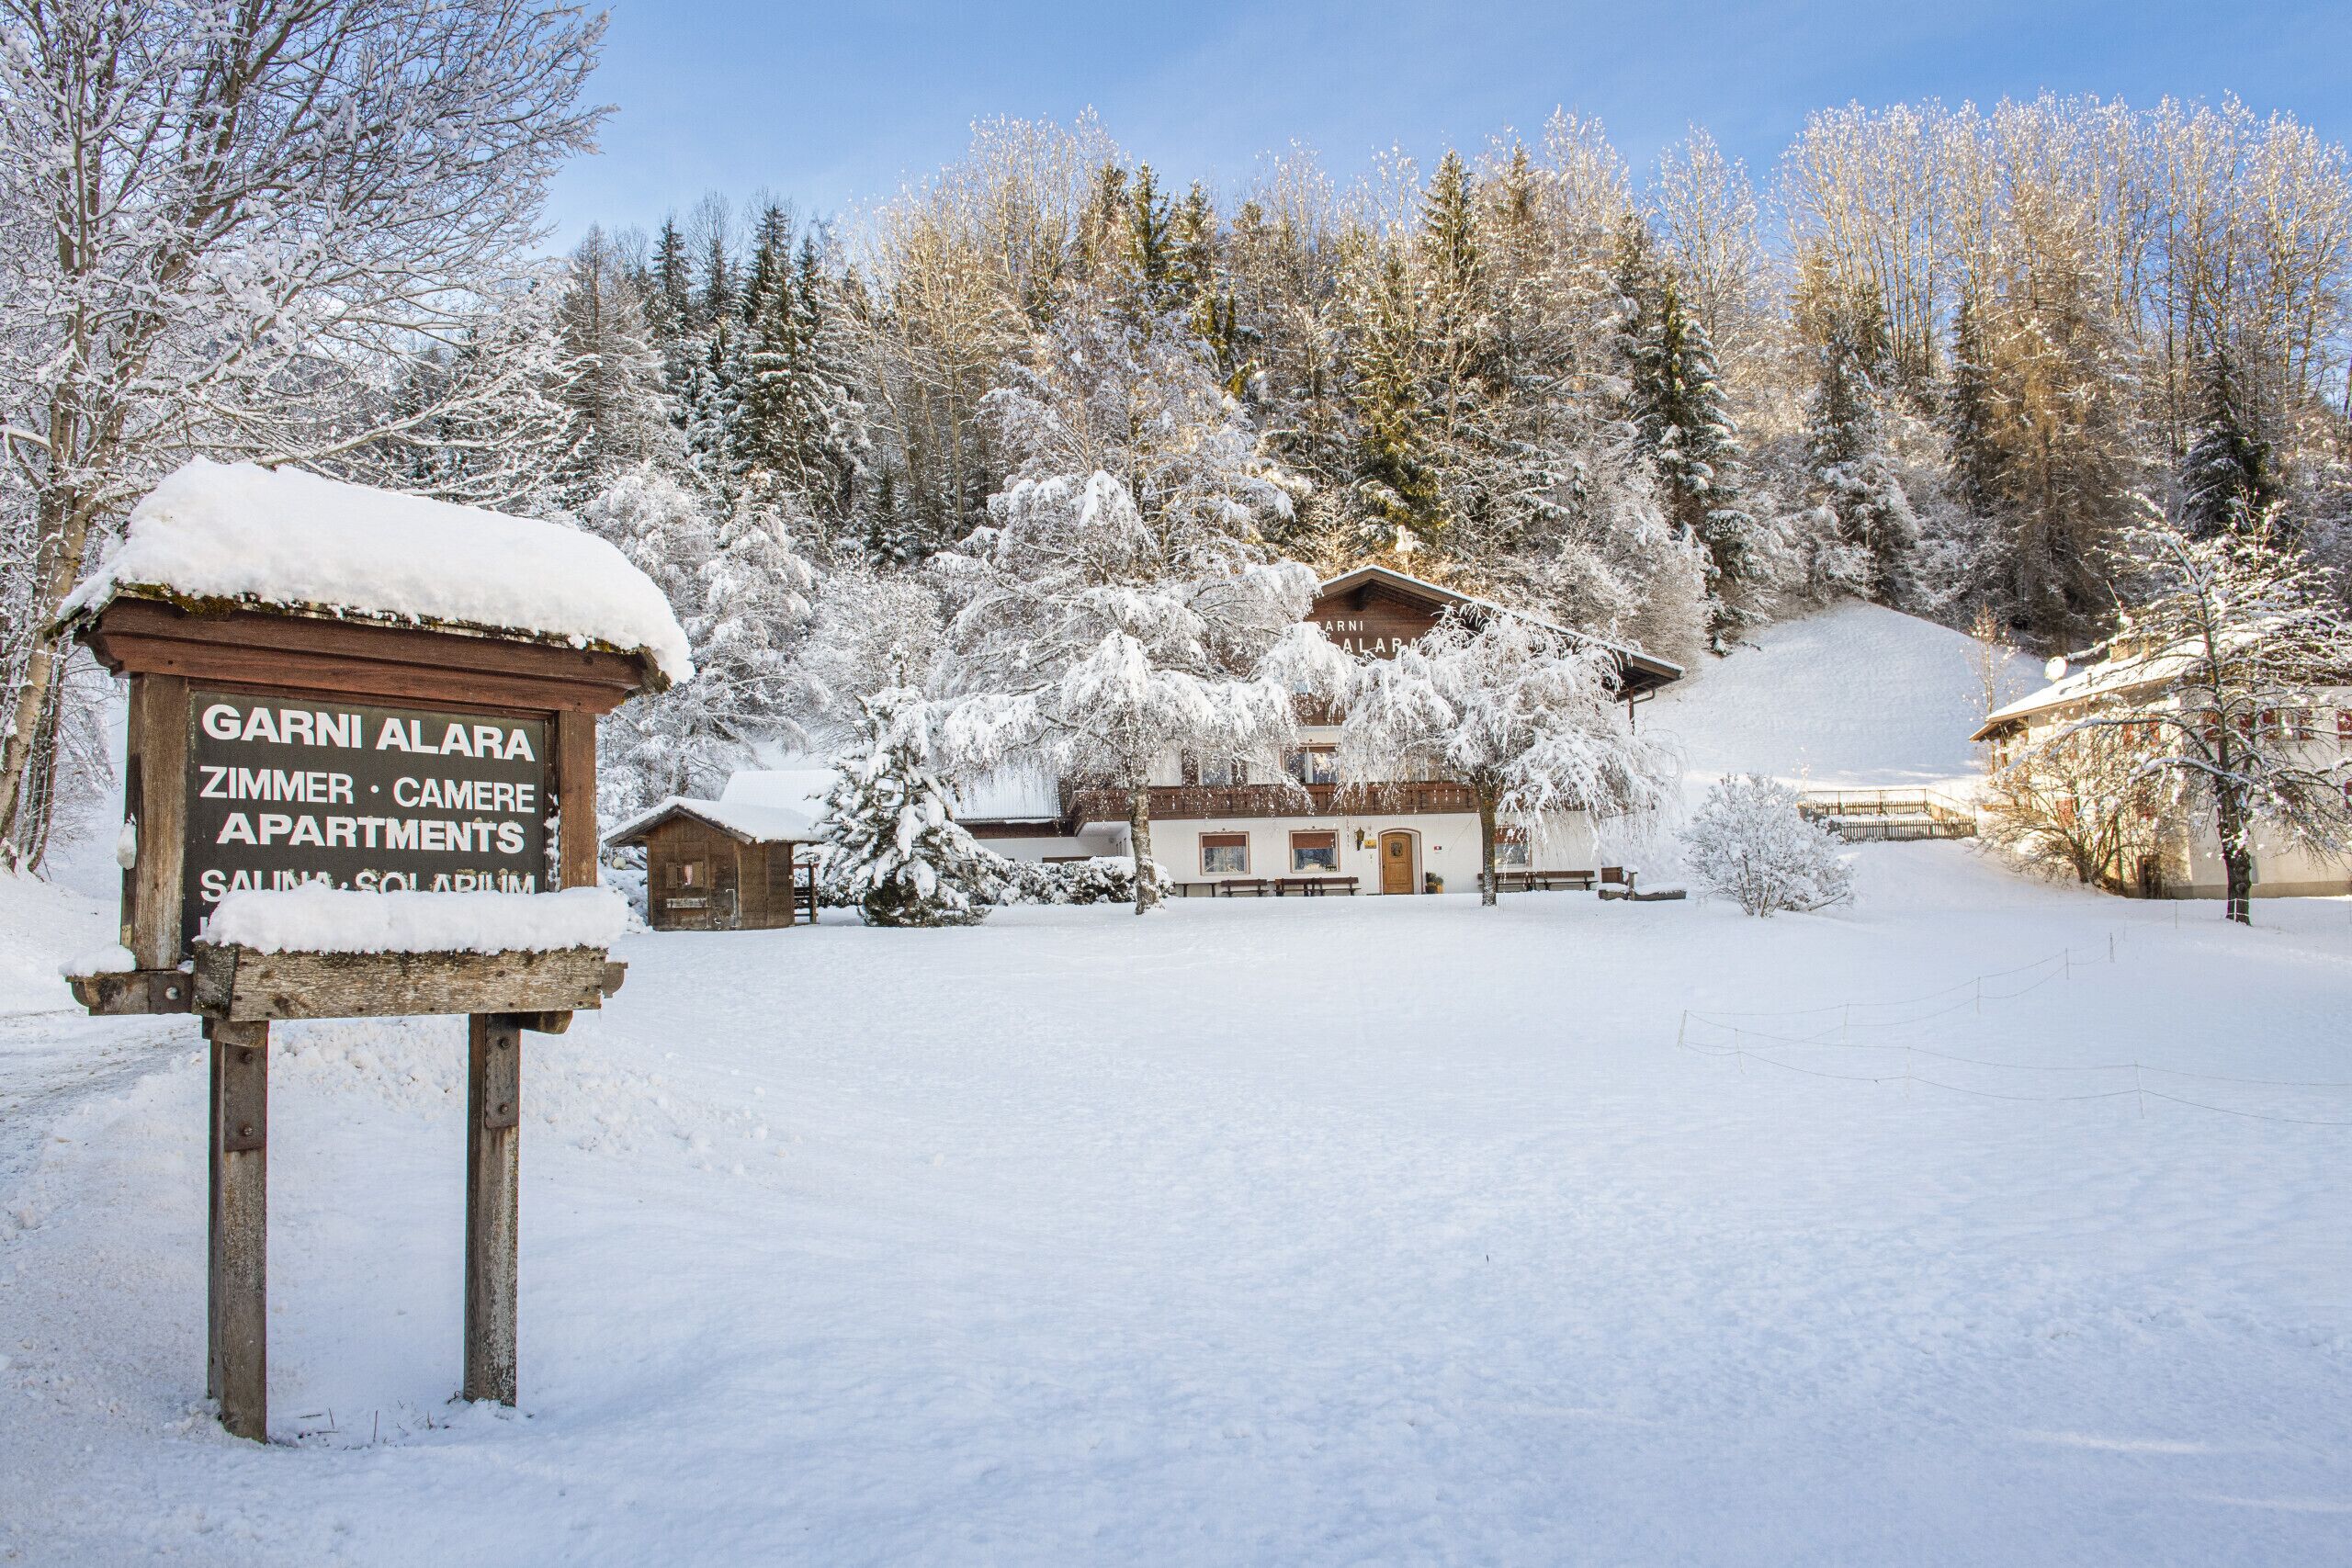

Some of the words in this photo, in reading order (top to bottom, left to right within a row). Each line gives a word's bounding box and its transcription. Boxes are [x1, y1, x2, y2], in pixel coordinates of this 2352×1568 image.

[1316, 620, 1363, 632] ARNI
[202, 704, 362, 749] GARNI
[376, 717, 536, 761] ALARA
[199, 765, 354, 805] ZIMMER
[393, 776, 536, 814] CAMERE
[216, 812, 525, 854] APARTMENTS
